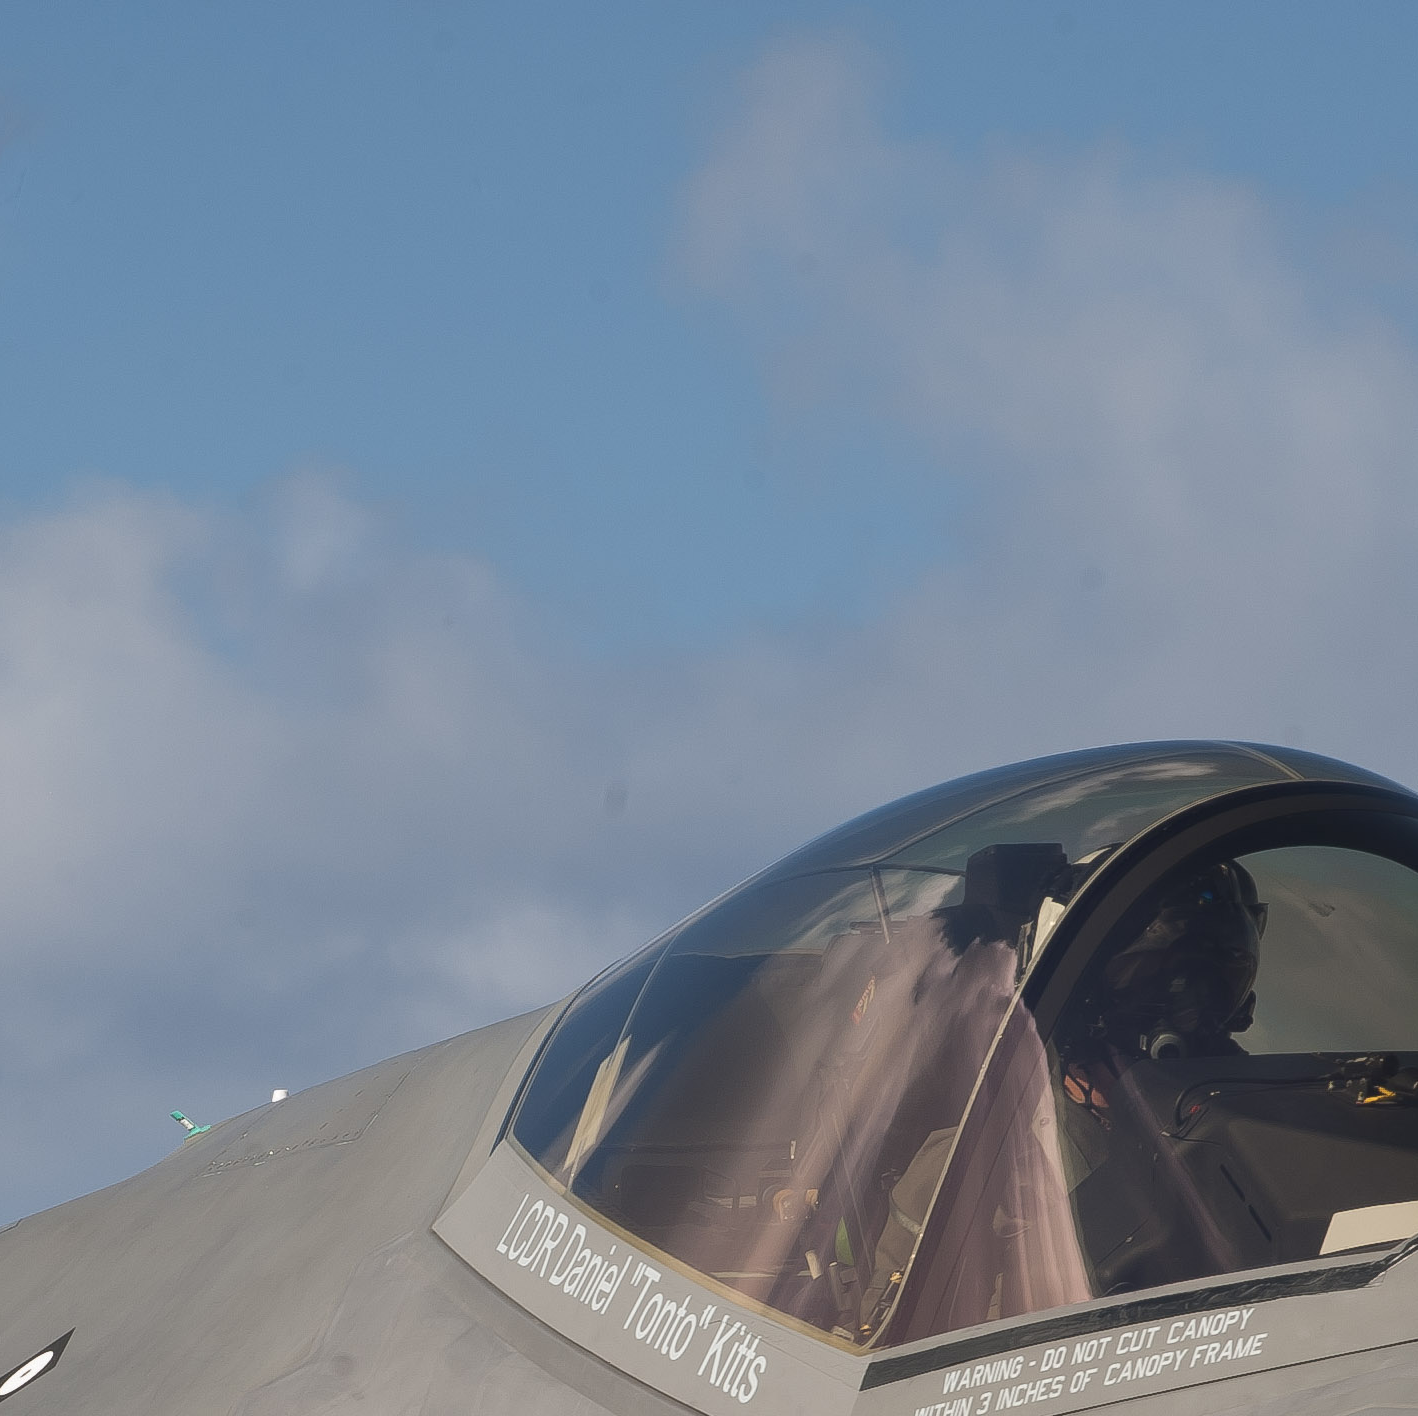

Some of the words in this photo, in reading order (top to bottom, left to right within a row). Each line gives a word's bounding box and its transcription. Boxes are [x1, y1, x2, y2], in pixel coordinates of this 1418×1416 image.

[496, 1193, 569, 1278] LCDR
[549, 1224, 633, 1315] Daniel
[623, 1262, 717, 1361] "Tonto"
[697, 1314, 767, 1404] Kitts
[942, 1356, 1023, 1395] WARNING
[1040, 1348, 1066, 1373] DO
[1071, 1337, 1112, 1367] NOT
[1116, 1326, 1161, 1356] CUT
[1166, 1308, 1256, 1344] CANOPY
[976, 1391, 991, 1415] 3
[995, 1376, 1066, 1411] INCHES
[1070, 1368, 1098, 1394] OF
[1103, 1349, 1188, 1387] CANOPY
[1189, 1333, 1269, 1369] FRAME
